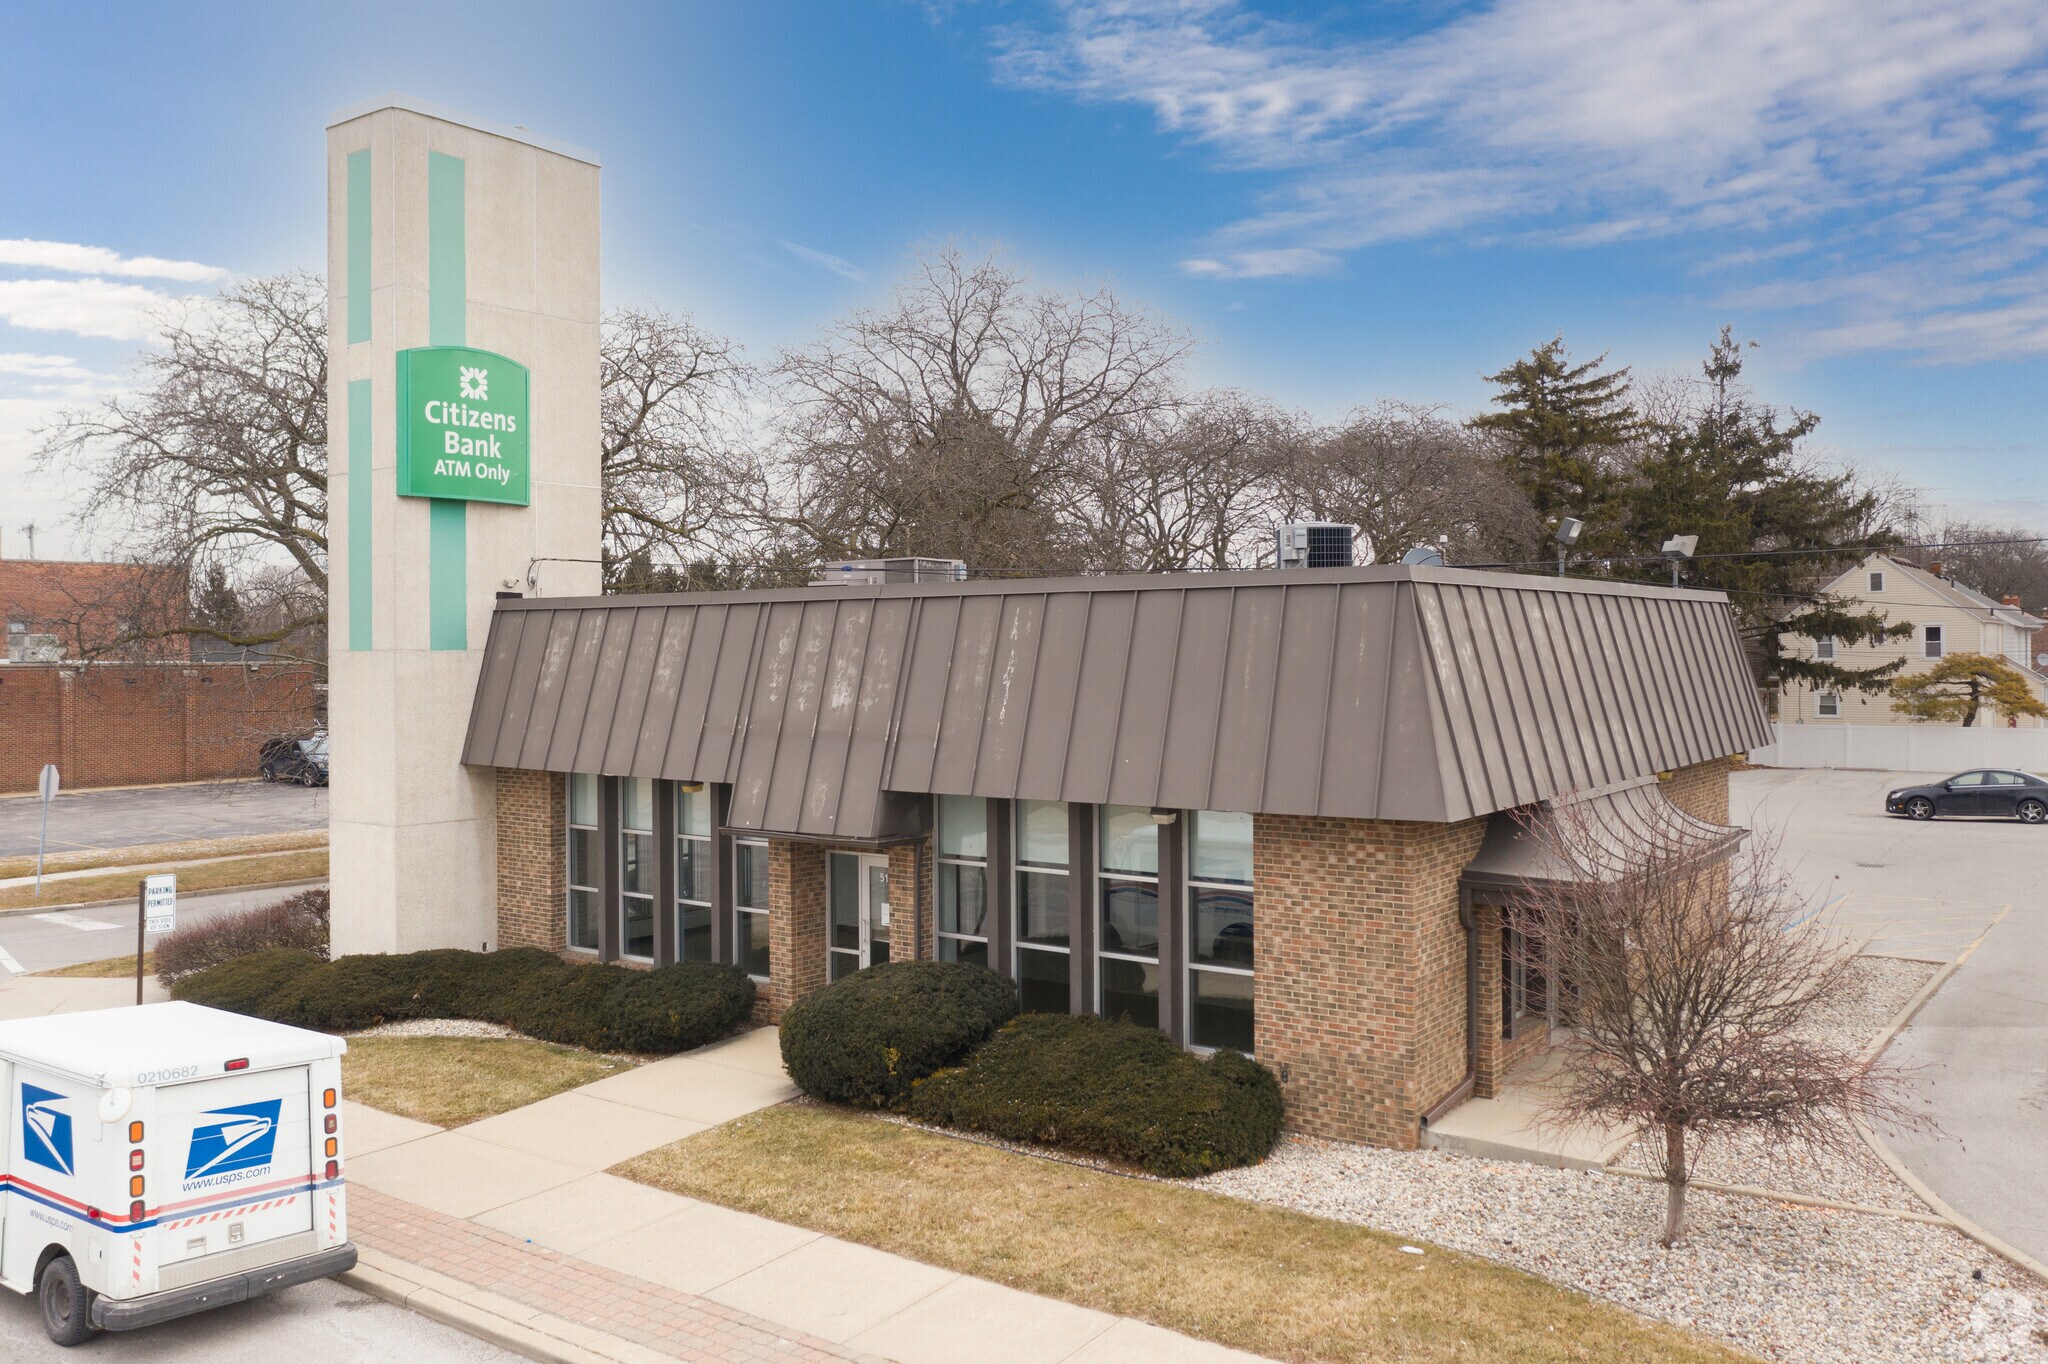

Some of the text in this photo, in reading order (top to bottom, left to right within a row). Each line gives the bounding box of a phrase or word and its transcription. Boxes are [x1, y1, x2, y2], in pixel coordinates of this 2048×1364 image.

[425, 401, 516, 432] Citizens
[445, 431, 502, 458] Bank
[434, 459, 510, 486] ATM Only
[148, 886, 173, 895] PARKING
[148, 898, 173, 907] PERMITTED
[137, 1065, 199, 1084] 0210682
[182, 1166, 271, 1192] www.usps.com
[29, 1208, 74, 1233] www.usps.com
